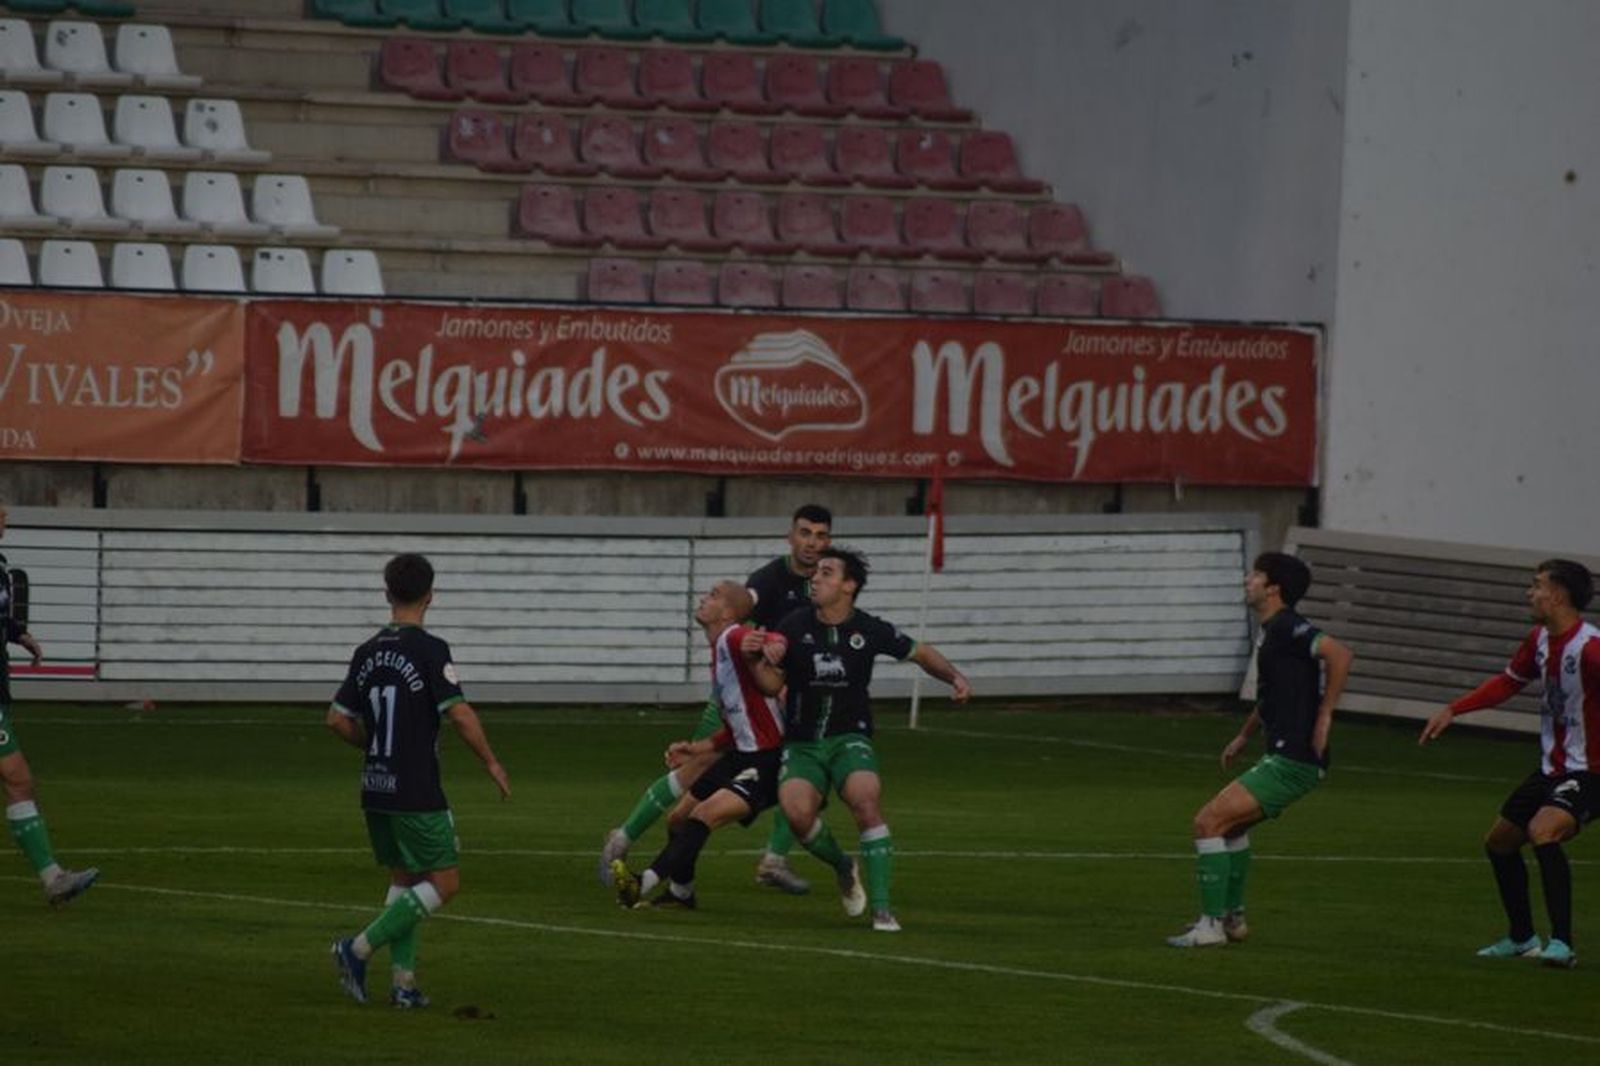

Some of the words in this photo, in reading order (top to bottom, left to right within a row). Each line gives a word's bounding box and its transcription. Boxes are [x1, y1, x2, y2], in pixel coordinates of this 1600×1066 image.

[436, 313, 534, 338] Jamones
[538, 322, 555, 345] y
[557, 315, 673, 342] Embutidos
[1063, 330, 1152, 355] Jamones
[1156, 337, 1172, 362] y
[1175, 332, 1289, 359] Embutidos
[277, 320, 672, 460] Melquiades
[729, 374, 850, 416] Melquiades
[911, 339, 1288, 479] Melquiades
[369, 685, 396, 757] 11
